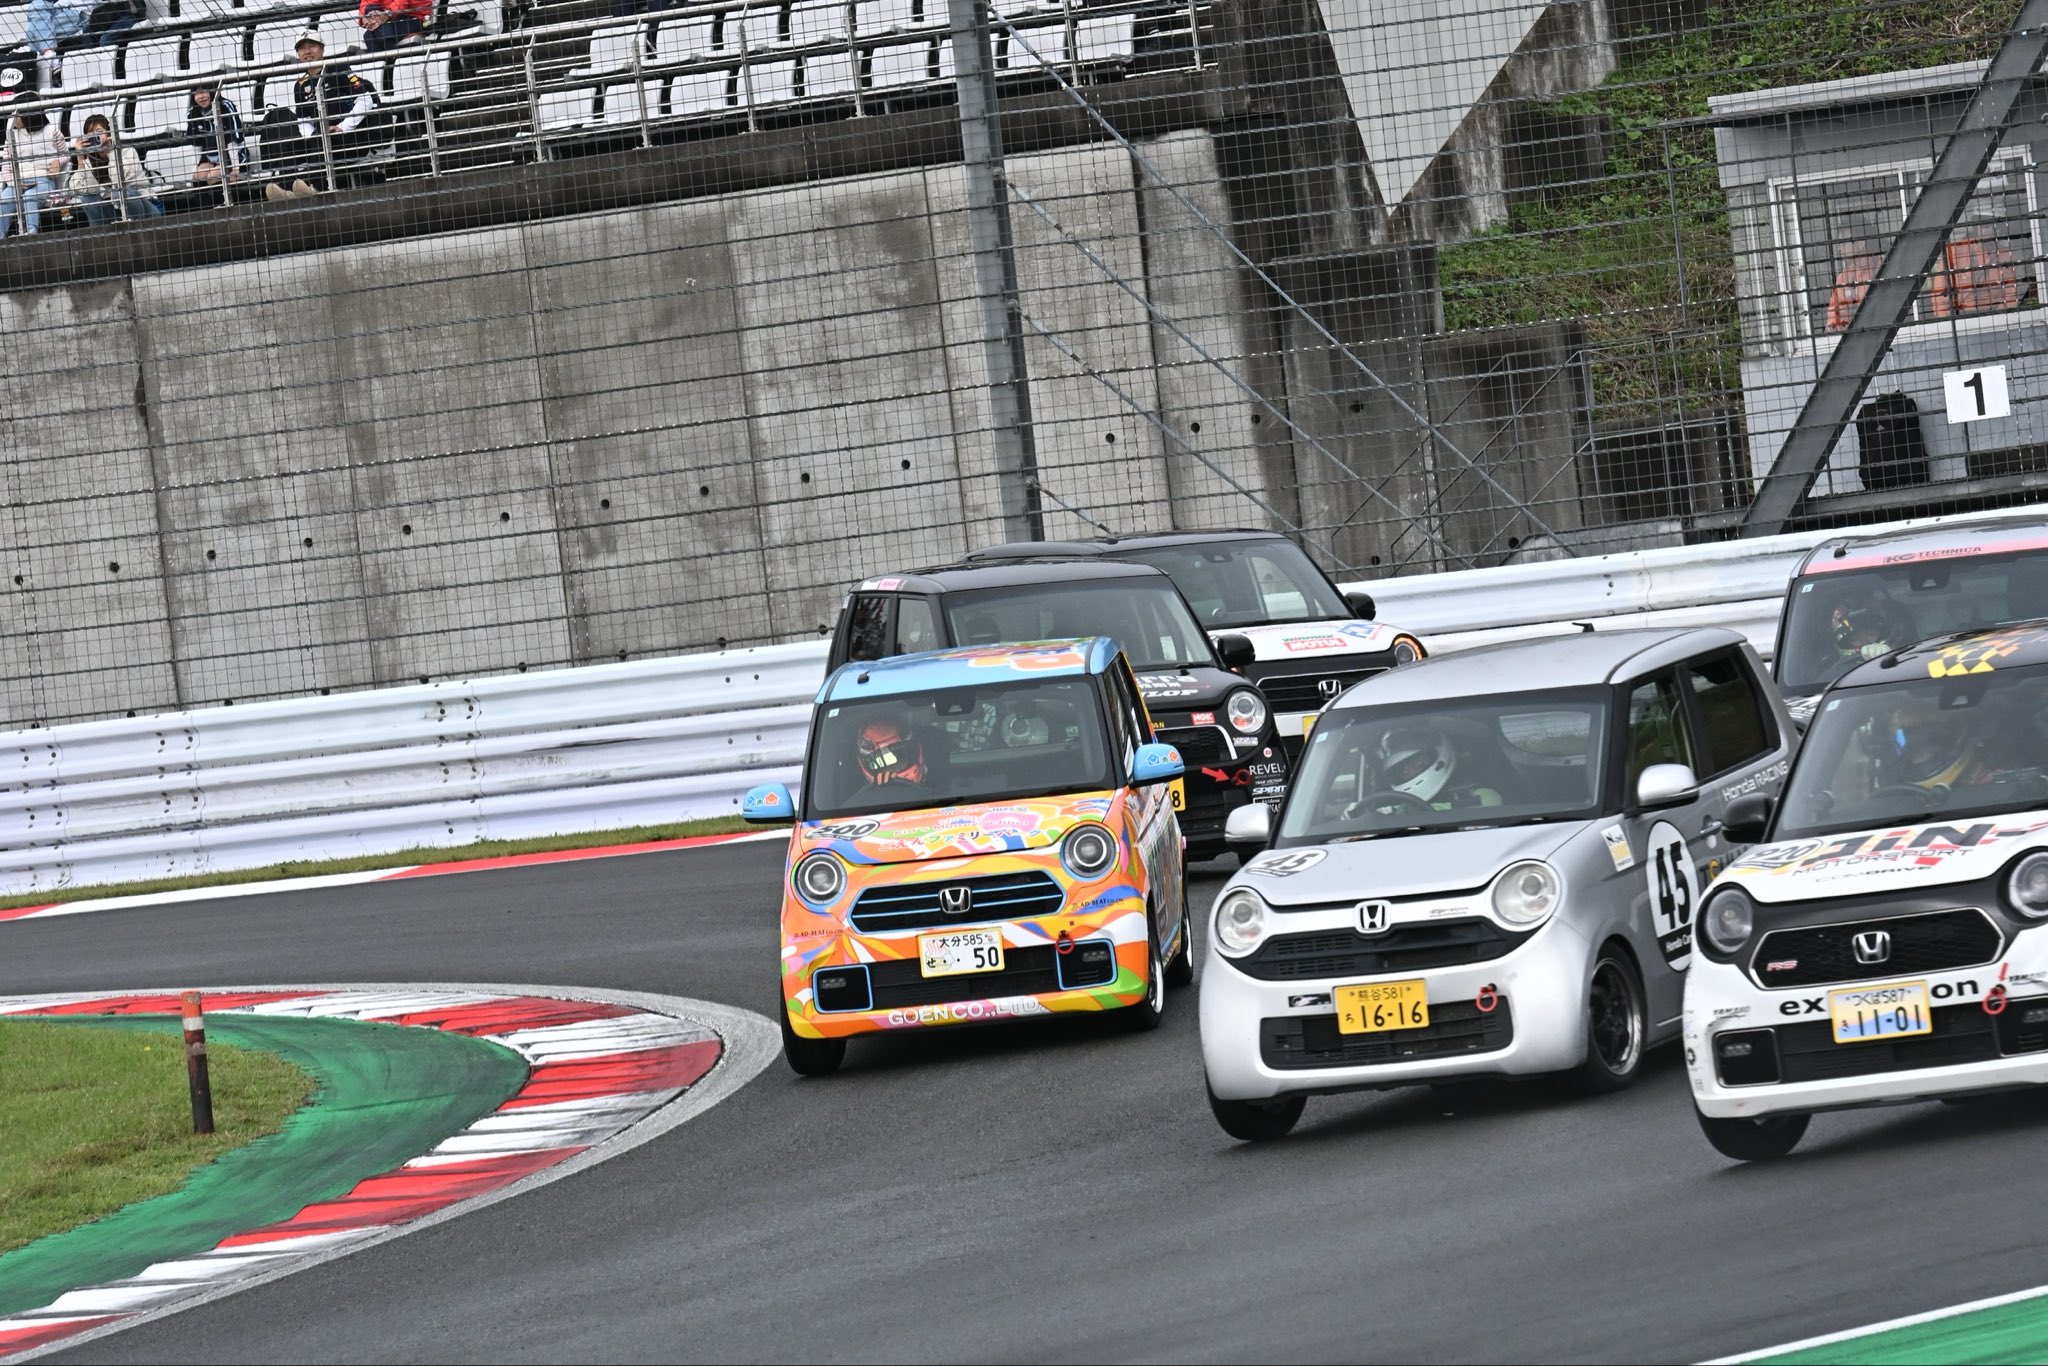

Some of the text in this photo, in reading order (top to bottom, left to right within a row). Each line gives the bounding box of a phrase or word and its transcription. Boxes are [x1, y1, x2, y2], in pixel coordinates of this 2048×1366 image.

[1964, 372, 1986, 416] 1
[1918, 547, 1982, 558] TECHNICA
[1290, 638, 1342, 650] MOTUL
[1193, 712, 1213, 721] NGK
[1754, 760, 1789, 789] RACING
[1253, 785, 1287, 795] SPIRIT
[1172, 790, 1181, 808] 8
[817, 822, 877, 836] 500
[1262, 853, 1321, 870] 45
[1792, 849, 1974, 876] MOTORSPORT
[1656, 840, 1691, 930] 45
[1666, 938, 1682, 954] Honda
[926, 958, 936, 968] せ
[1767, 960, 1798, 971] RS
[1361, 1001, 1423, 1029] 16-16
[1858, 1004, 1922, 1036] 11-01
